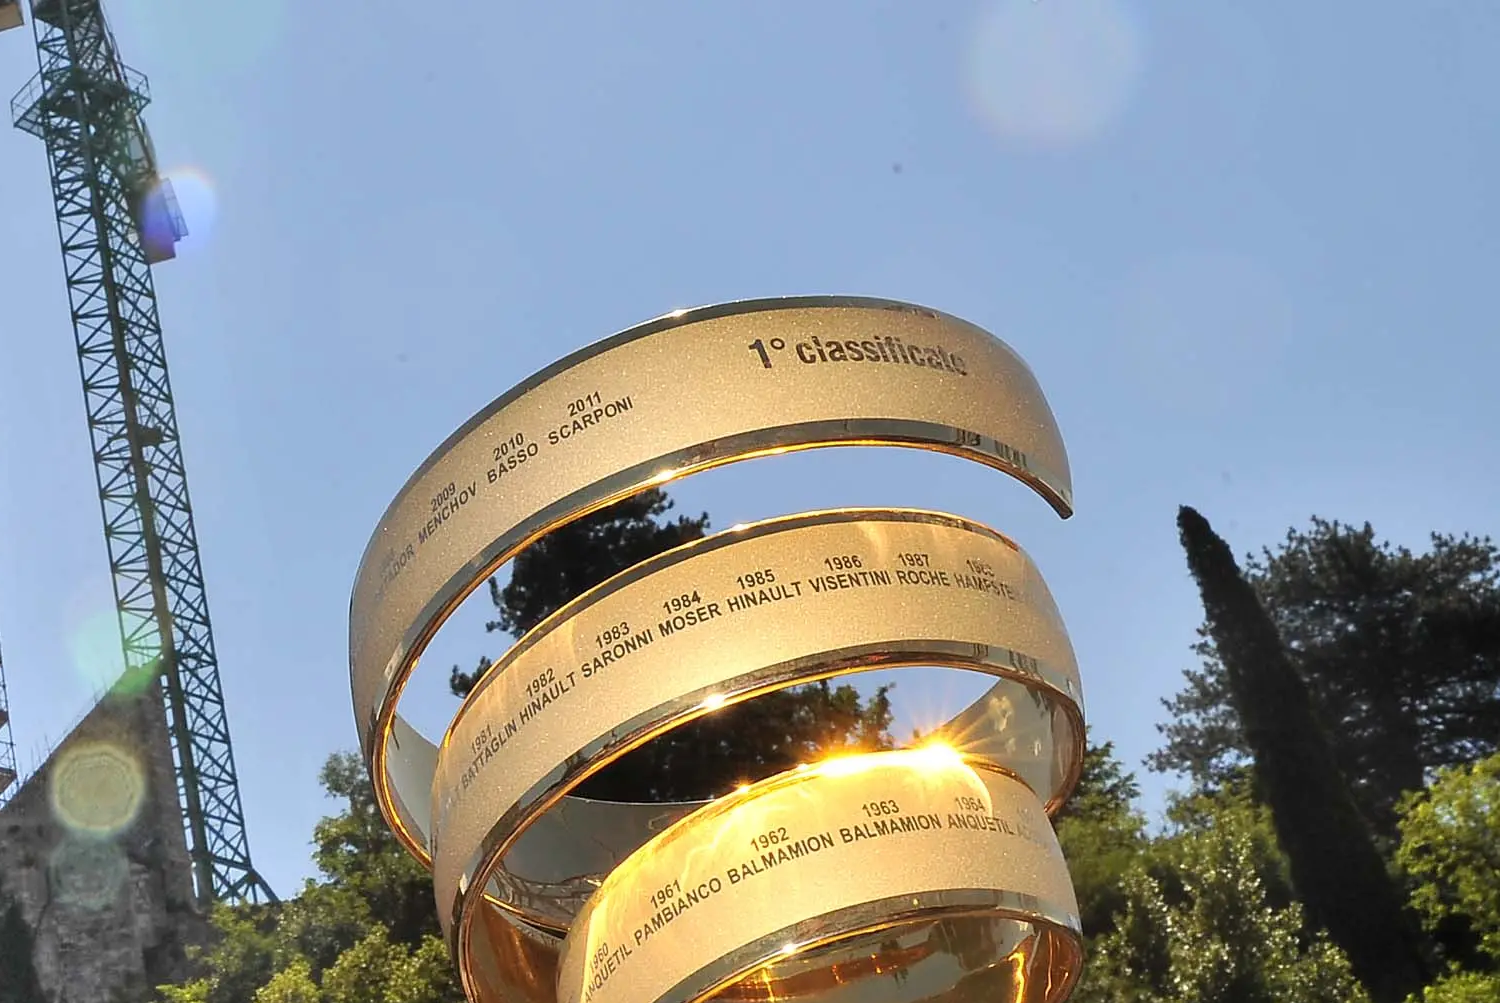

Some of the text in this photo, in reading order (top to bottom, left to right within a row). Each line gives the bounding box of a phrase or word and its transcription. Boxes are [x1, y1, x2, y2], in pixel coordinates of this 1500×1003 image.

[748, 337, 786, 369] 1°
[417, 396, 634, 546] MENCHOV BASSO SCARPONI
[430, 390, 602, 514] 2009 2010 2011
[460, 719, 517, 790] BATTAGLIN
[519, 671, 577, 726] HINAULT
[581, 628, 654, 679] SARONNI
[658, 602, 722, 638] MOSER
[727, 580, 802, 613] HINAULT
[808, 570, 892, 594] VISENTINI
[896, 570, 950, 587] ROCHE
[471, 723, 493, 755] 1981
[525, 667, 556, 698] 1982
[595, 621, 631, 649] 1983
[662, 590, 702, 615] 1984
[736, 569, 776, 590] 1985
[824, 555, 862, 572] 1986
[898, 552, 930, 568] 1987
[633, 877, 722, 946] PAMBIANCO
[726, 831, 835, 886] BALMAMION
[839, 813, 942, 844] BALMAMION
[947, 813, 1016, 836] ANQUETIL
[650, 879, 682, 910] 1961
[750, 826, 790, 852] 1962
[861, 799, 900, 818] 1963
[955, 796, 986, 812] 1964
